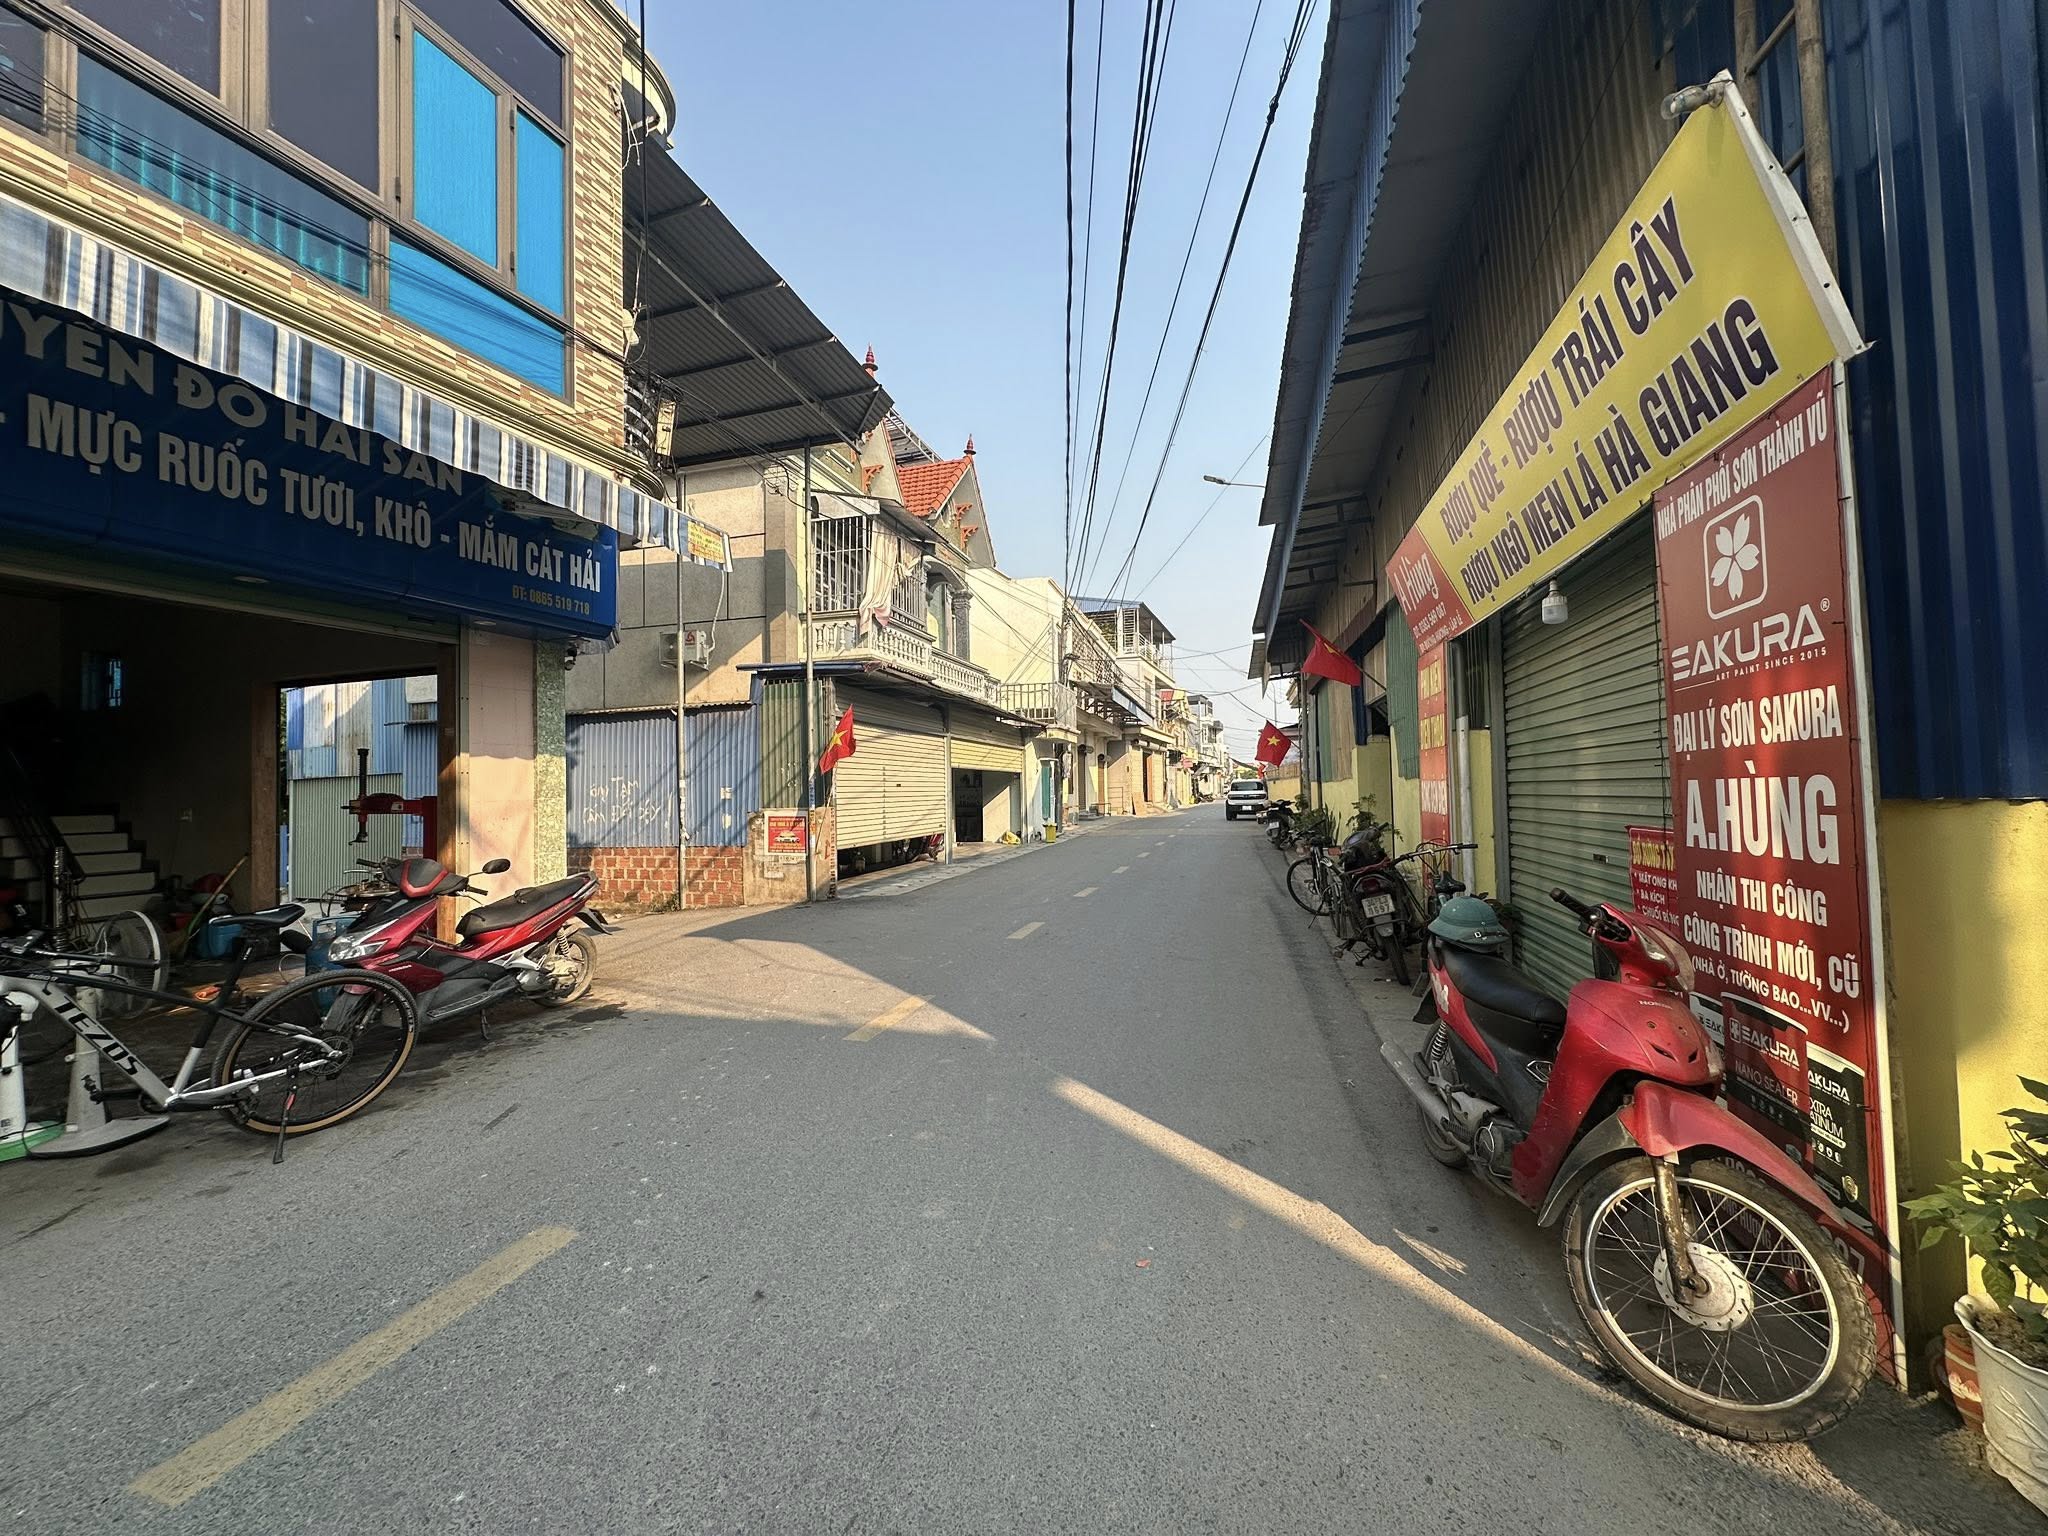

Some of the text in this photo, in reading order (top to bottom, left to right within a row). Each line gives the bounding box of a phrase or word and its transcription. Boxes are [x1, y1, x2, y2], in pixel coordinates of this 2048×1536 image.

[0, 301, 154, 396] YÊN
[1439, 481, 1477, 546] RƯỢU
[1468, 439, 1505, 514] QUÊ
[1503, 371, 1563, 470] RƯỢU
[1552, 293, 1625, 409] TRÁI
[1613, 195, 1694, 336] CÂY
[27, 392, 143, 475] MỰC
[158, 432, 269, 506] RUỐC
[280, 467, 364, 537] TƯƠI,
[375, 495, 432, 549] KHÔ
[458, 514, 518, 572] MẮM
[525, 538, 564, 583] CÁT
[569, 548, 601, 593] HẢI
[1460, 298, 1780, 605] RƯỢU NGÔ MEN LÁ HÀ GIANG
[1657, 390, 1828, 541] NHÀ PHÂN PHỐI SƠN THÀNH VŨ
[1671, 603, 1826, 682] SAKURA
[1734, 664, 1760, 677] PAINT
[1764, 654, 1795, 670] SINCE
[1800, 646, 1827, 662] 2015
[1673, 684, 1843, 761] ĐẠI LÝ SƠN SAKURA
[1686, 760, 1840, 865] A.HÙNG
[1696, 867, 1828, 927] NHẬN THI CÔNG
[1683, 912, 1860, 999] CÔNG TRÌNH MỚI, CŨ
[1730, 967, 1770, 997] TƯỜNG
